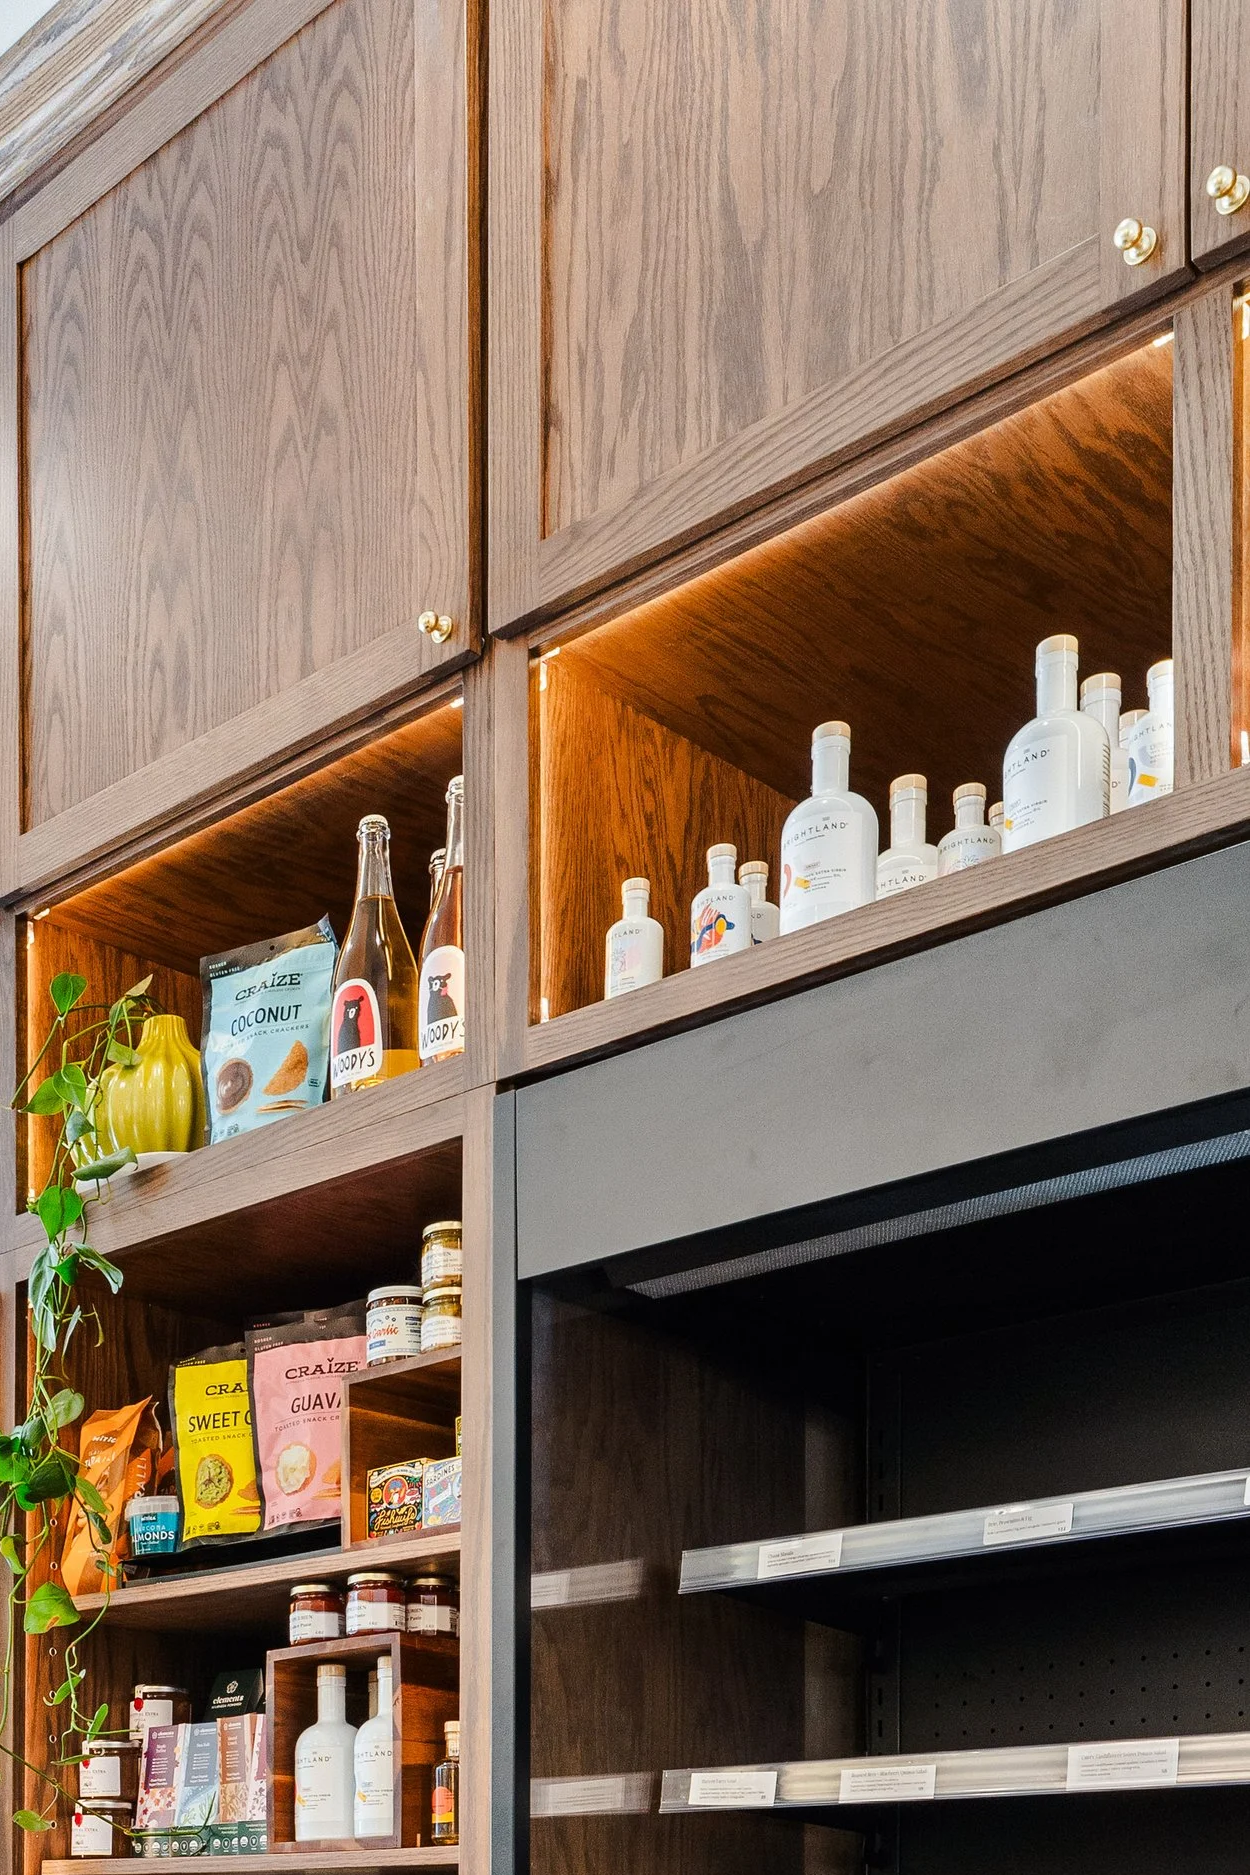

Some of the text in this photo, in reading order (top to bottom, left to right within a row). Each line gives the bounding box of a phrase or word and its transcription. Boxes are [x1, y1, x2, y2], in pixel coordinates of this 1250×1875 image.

[231, 1004, 302, 1037] COCONUT
[270, 1024, 310, 1034] CRACKERS
[188, 1410, 241, 1433] SWEET
[303, 1416, 327, 1424] SNACK
[191, 1432, 246, 1445] TOASTED SNACK
[213, 1695, 244, 1704] elements
